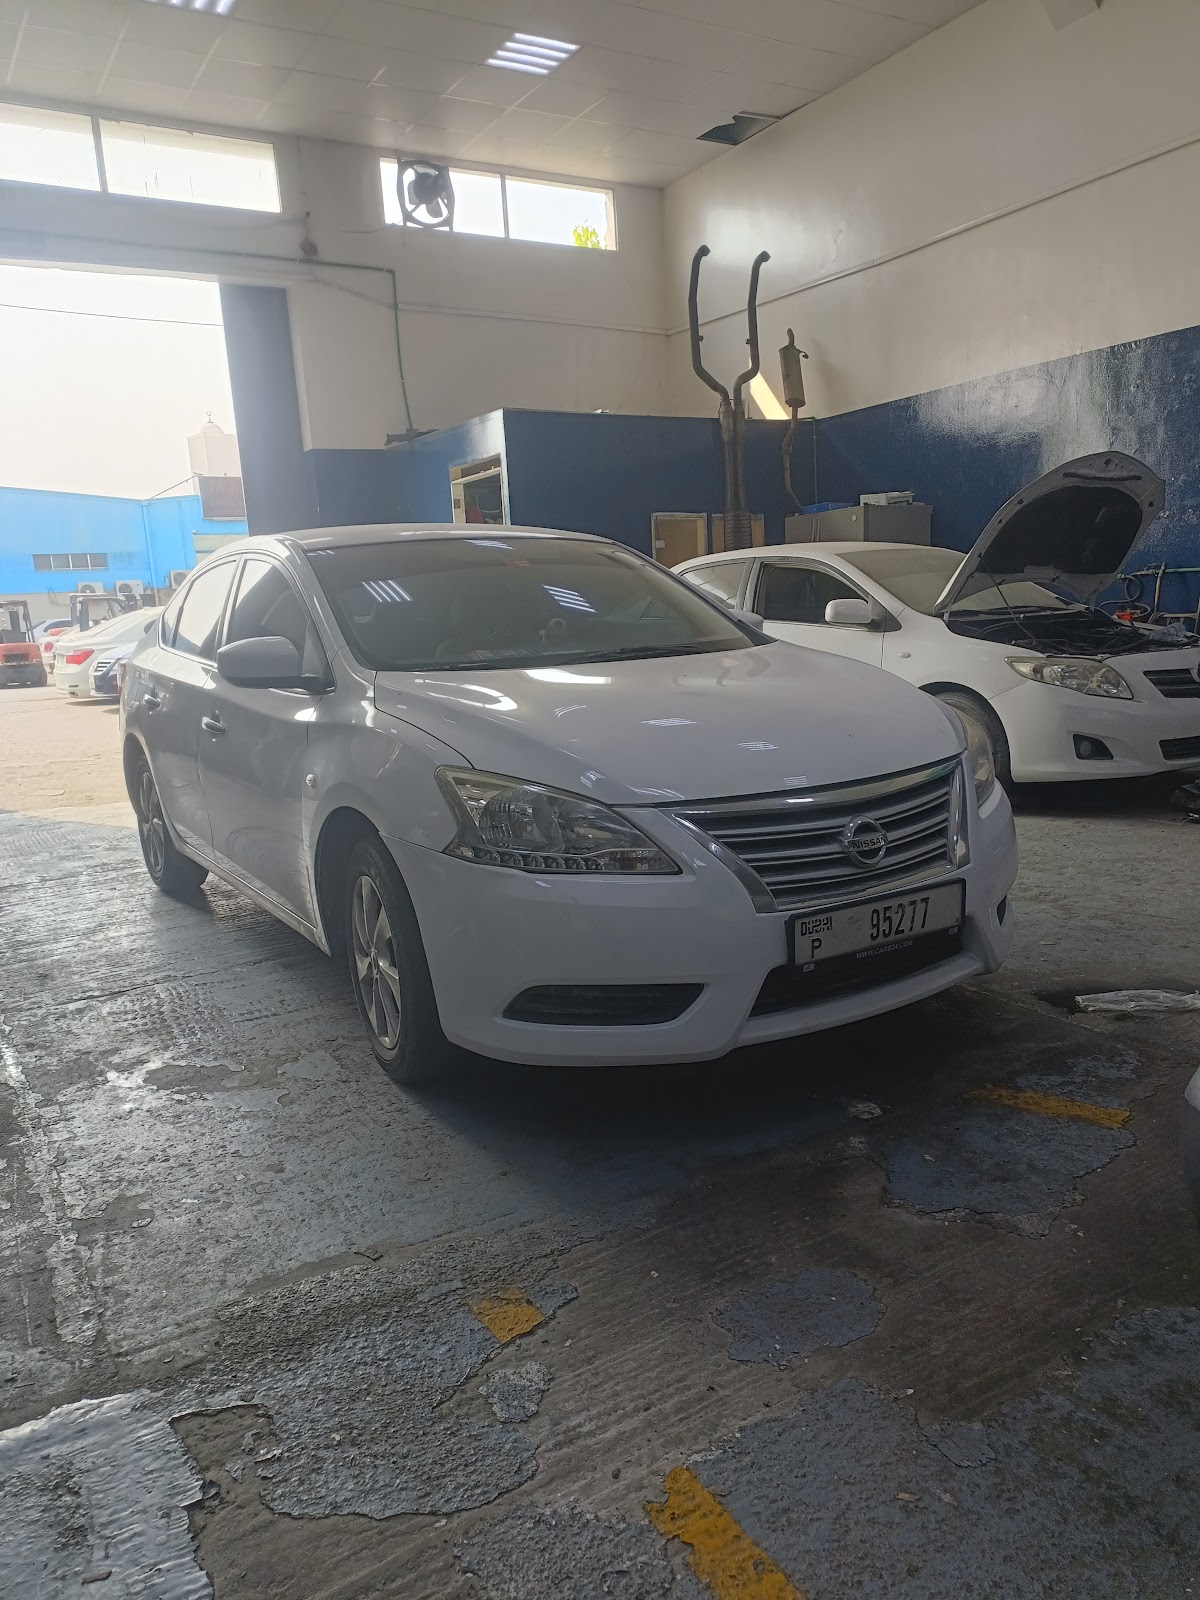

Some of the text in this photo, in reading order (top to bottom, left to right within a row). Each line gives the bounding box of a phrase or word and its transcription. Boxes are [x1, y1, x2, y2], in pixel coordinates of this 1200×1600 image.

[852, 836, 886, 849] NISSAN
[870, 897, 930, 941] 95277
[811, 937, 822, 958] P
